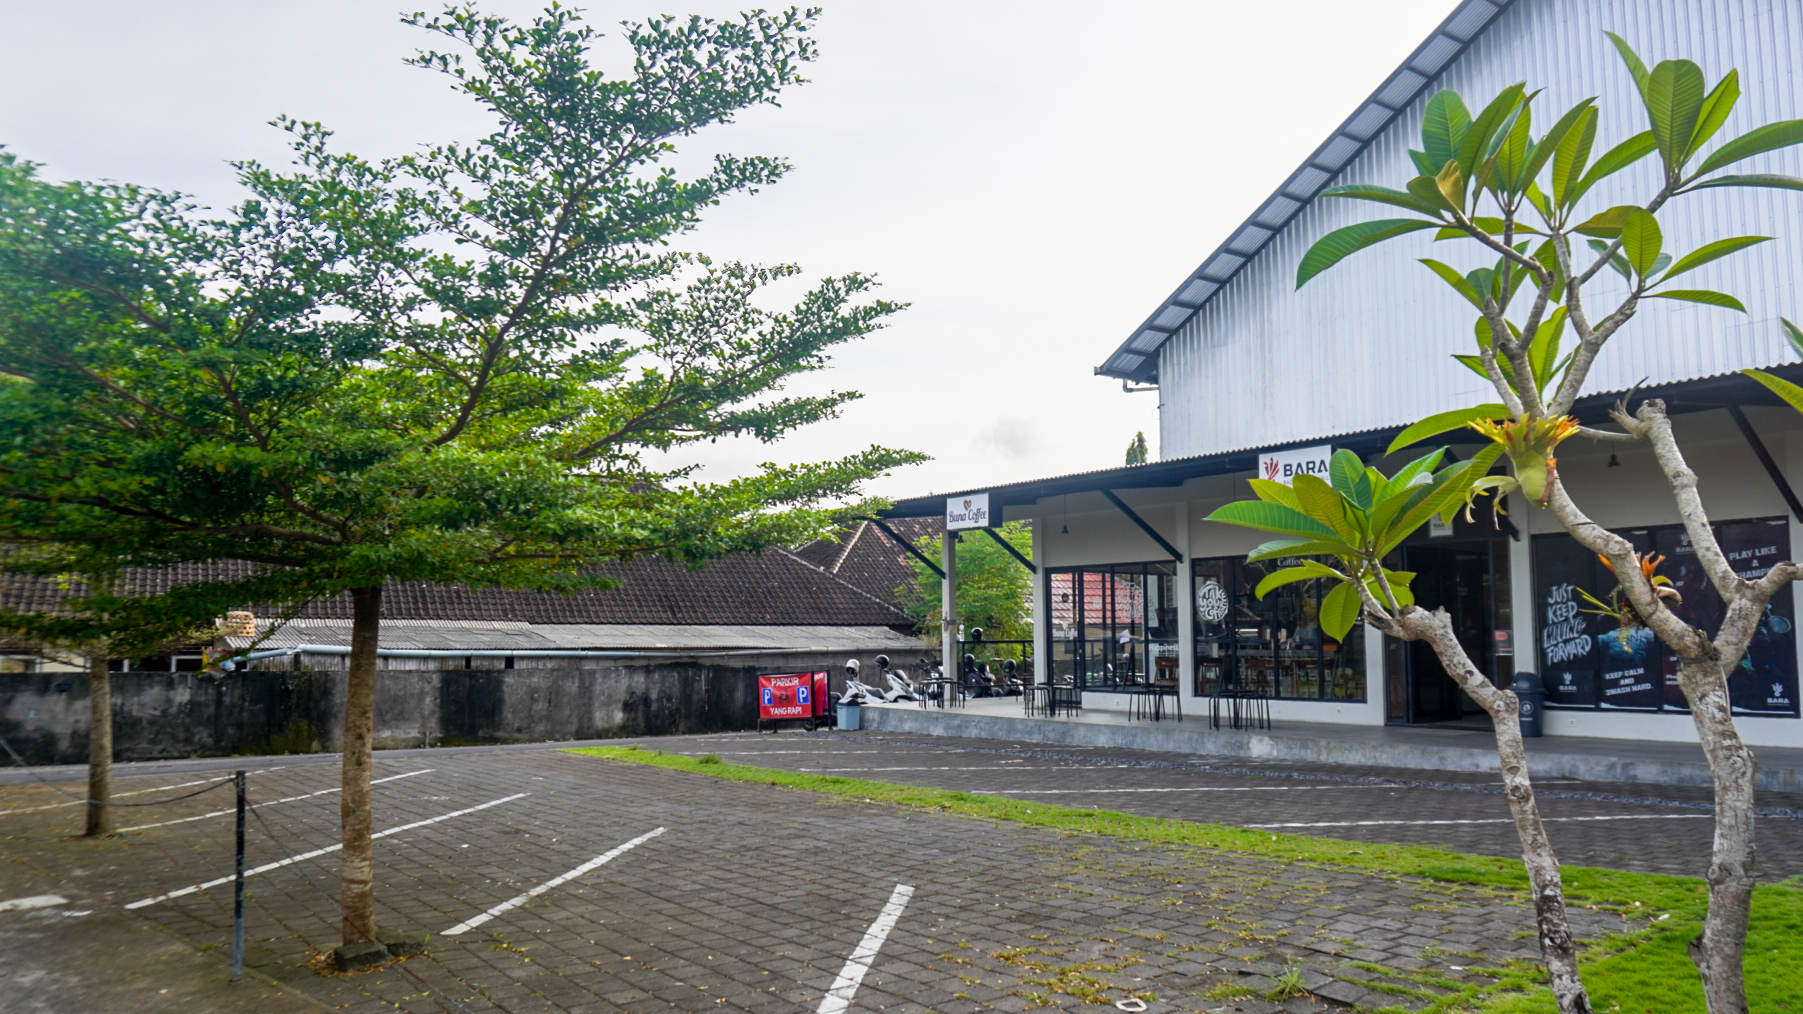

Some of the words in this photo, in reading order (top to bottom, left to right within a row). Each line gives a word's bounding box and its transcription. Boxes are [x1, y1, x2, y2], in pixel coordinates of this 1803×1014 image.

[1283, 459, 1328, 477] BARA
[949, 511, 966, 523] Buna
[967, 507, 986, 523] Coffee
[1729, 550, 1753, 560] PLAY
[1755, 546, 1777, 556] LIKE
[1752, 559, 1759, 567] A
[1200, 585, 1227, 601] TAKE
[1548, 583, 1575, 604] JUST
[1548, 601, 1578, 624] KEEP
[1149, 643, 1179, 653] Happiness
[1546, 634, 1592, 666] FORWARD
[1605, 671, 1623, 680] KEEP
[1624, 667, 1645, 677] CALM
[771, 677, 799, 687] PARKIR
[1620, 677, 1635, 685] AND
[799, 687, 808, 703] P
[1605, 686, 1631, 696] SMASH
[1631, 683, 1654, 692] HARD.
[764, 690, 771, 705] P
[770, 707, 787, 715] YANG
[787, 706, 802, 715] RAPI
